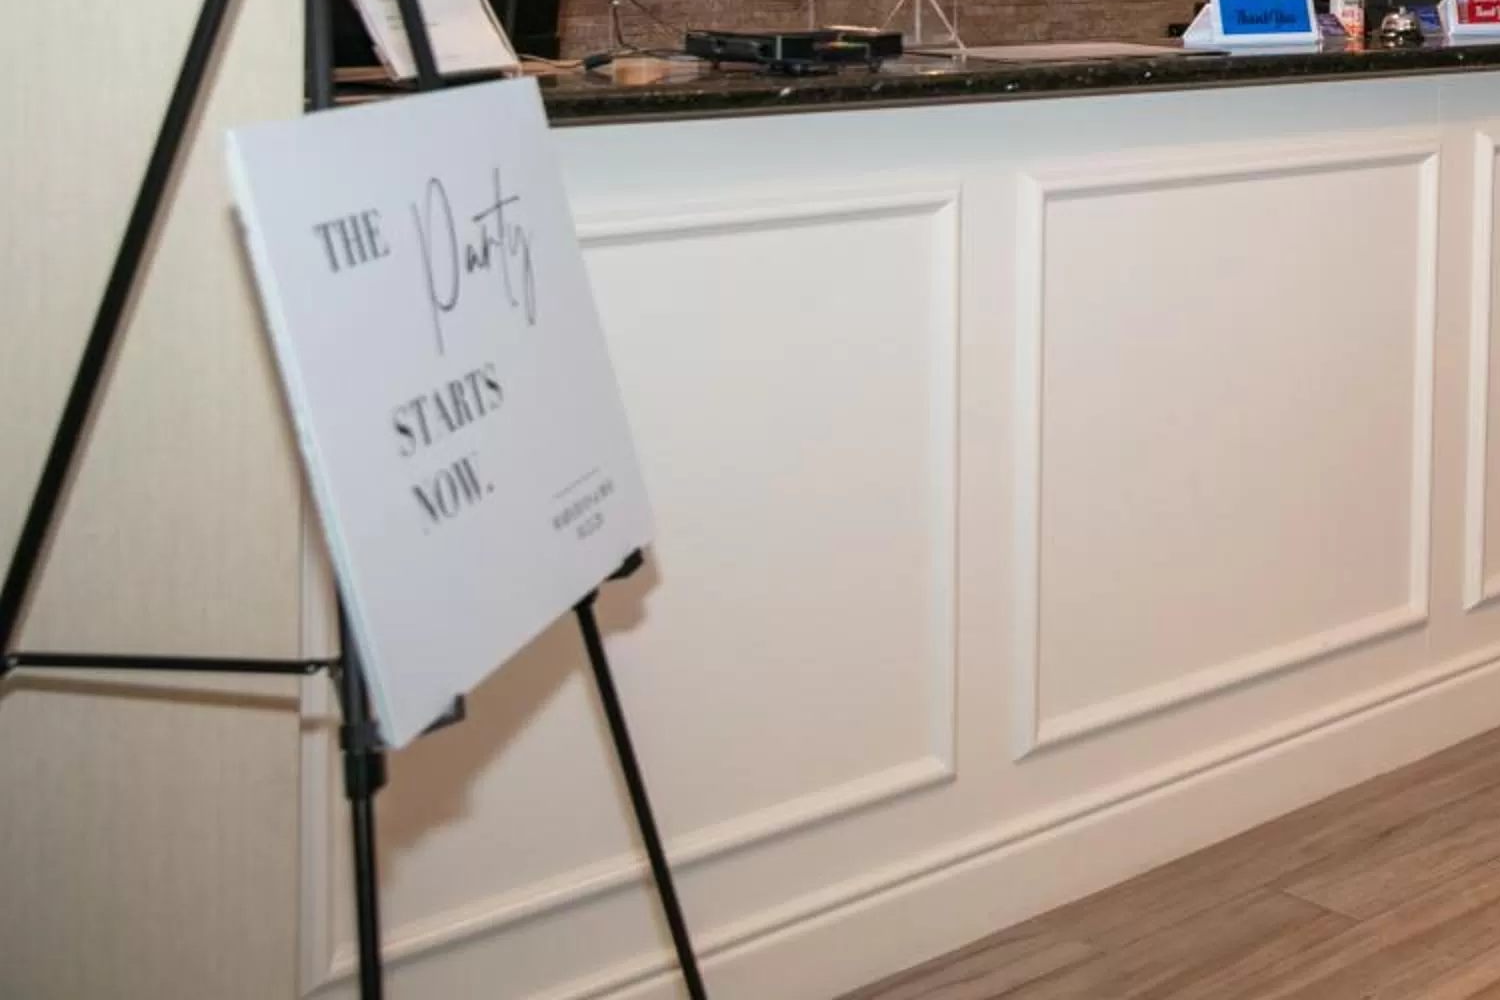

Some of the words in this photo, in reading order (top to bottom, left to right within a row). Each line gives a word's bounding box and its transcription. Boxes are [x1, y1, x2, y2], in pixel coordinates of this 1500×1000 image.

[312, 208, 391, 273] THE
[408, 167, 536, 355] Party
[392, 363, 504, 457] STARTS
[412, 452, 495, 535] NOW.
